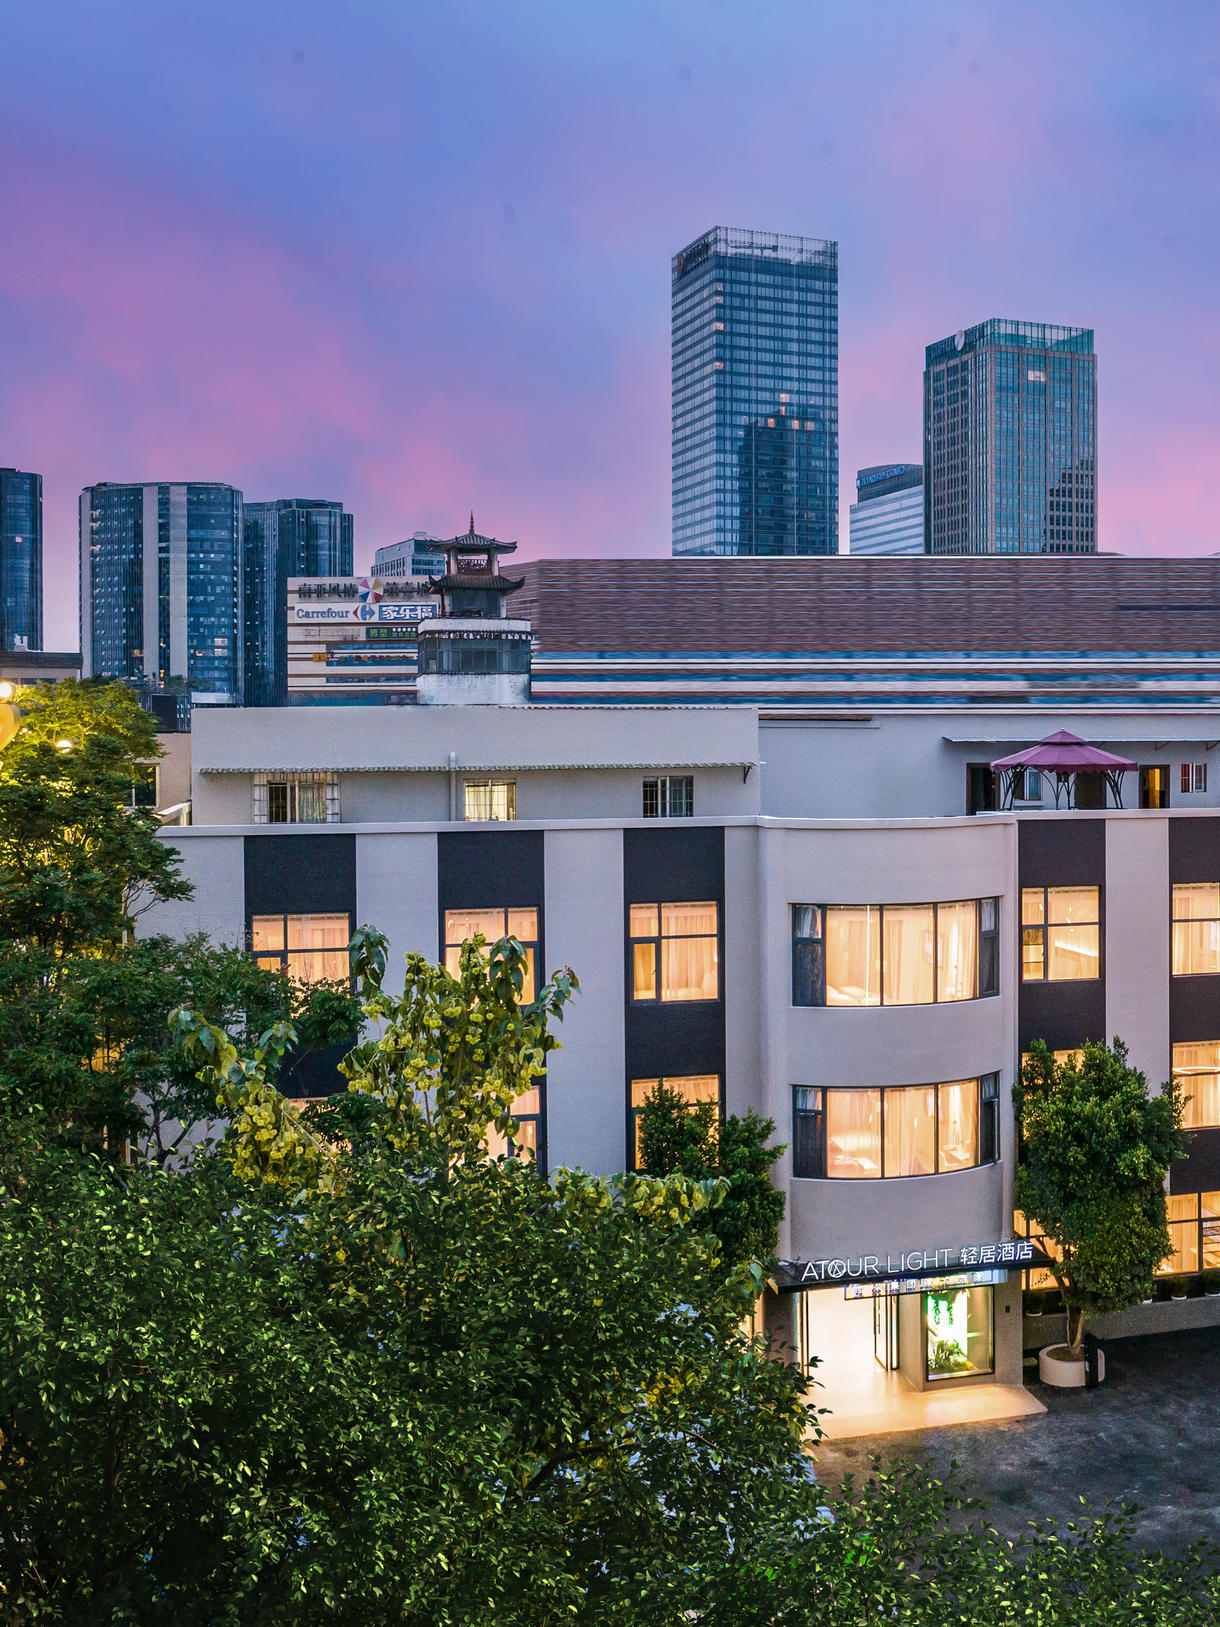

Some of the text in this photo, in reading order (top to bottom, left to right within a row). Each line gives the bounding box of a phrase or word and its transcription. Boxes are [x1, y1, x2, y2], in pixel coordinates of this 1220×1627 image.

[296, 605, 433, 620] Carrefour 家乐福
[801, 1241, 1034, 1282] ATOUR LIGHT 轻居酒店
